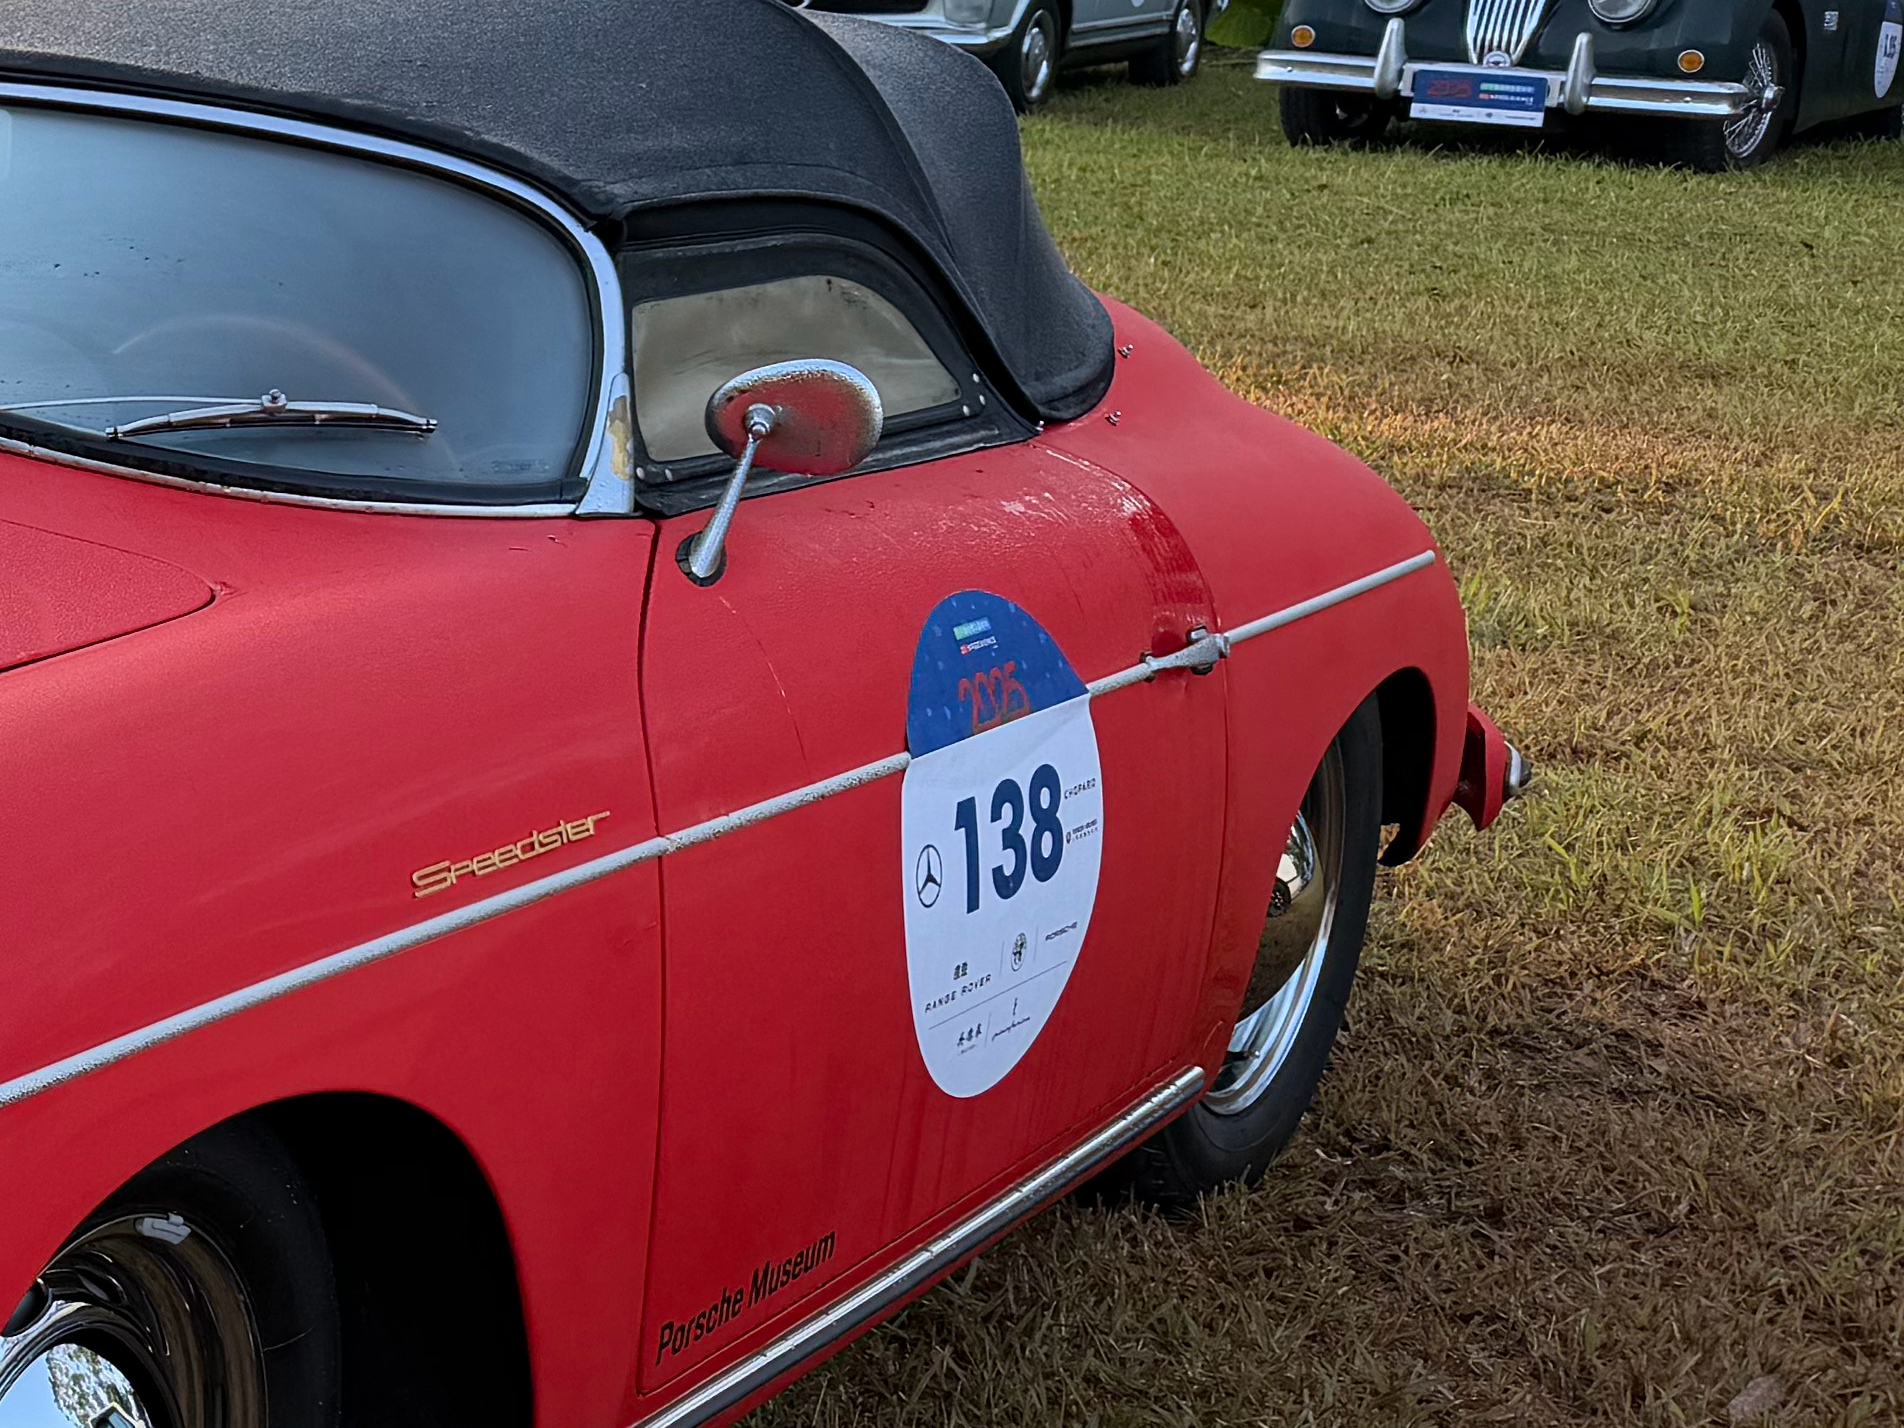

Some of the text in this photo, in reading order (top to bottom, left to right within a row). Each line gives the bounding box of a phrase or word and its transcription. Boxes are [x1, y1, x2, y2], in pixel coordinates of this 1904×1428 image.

[958, 659, 1031, 735] 2025
[412, 810, 611, 899] Speedster
[954, 763, 1064, 915] 138
[656, 1230, 836, 1366] Porsche Museum
